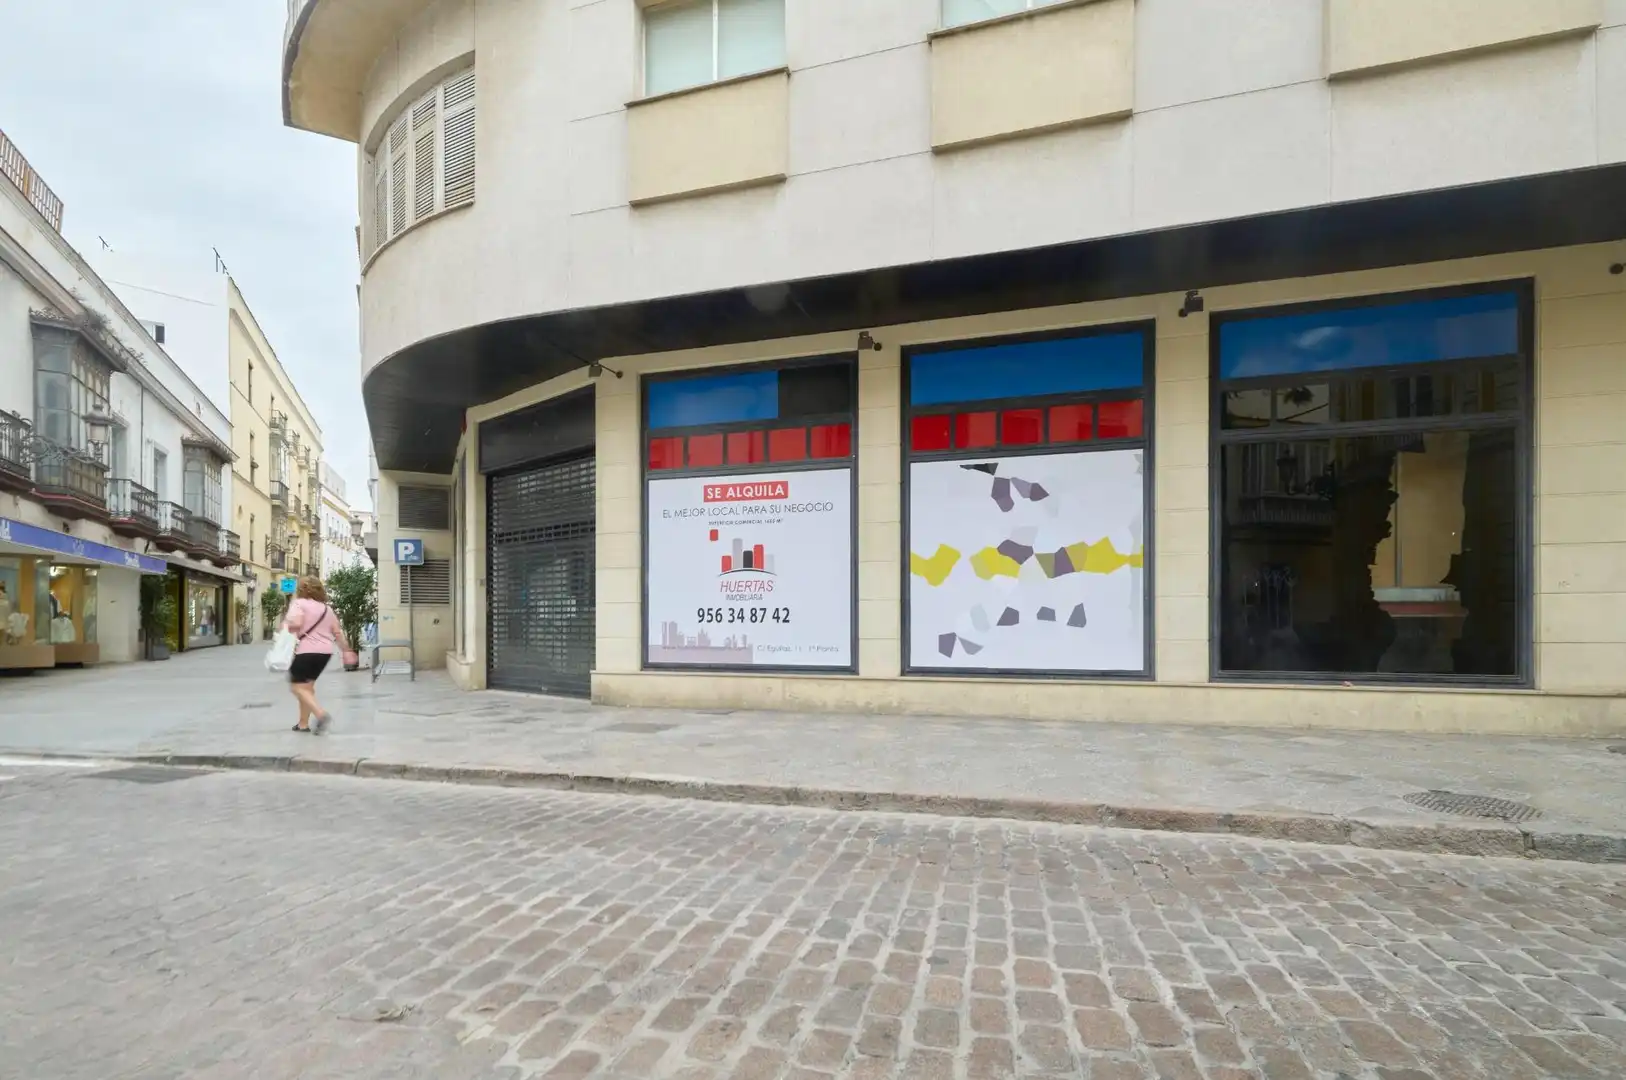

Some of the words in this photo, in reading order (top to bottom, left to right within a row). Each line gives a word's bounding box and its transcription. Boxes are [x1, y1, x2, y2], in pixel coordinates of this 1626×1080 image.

[707, 487, 722, 499] SE
[727, 484, 785, 498] ALQUILA
[662, 509, 672, 518] EL
[674, 507, 706, 518] MEJOR
[708, 506, 740, 517] LOCAL
[742, 504, 767, 515] PARA
[769, 503, 781, 514] SU
[784, 501, 834, 513] NEGOCIO
[398, 542, 415, 561] P
[720, 579, 774, 593] HUERTAS
[697, 607, 723, 623] 956
[728, 607, 745, 623] 34
[750, 607, 767, 623] 87
[772, 607, 790, 623] 42
